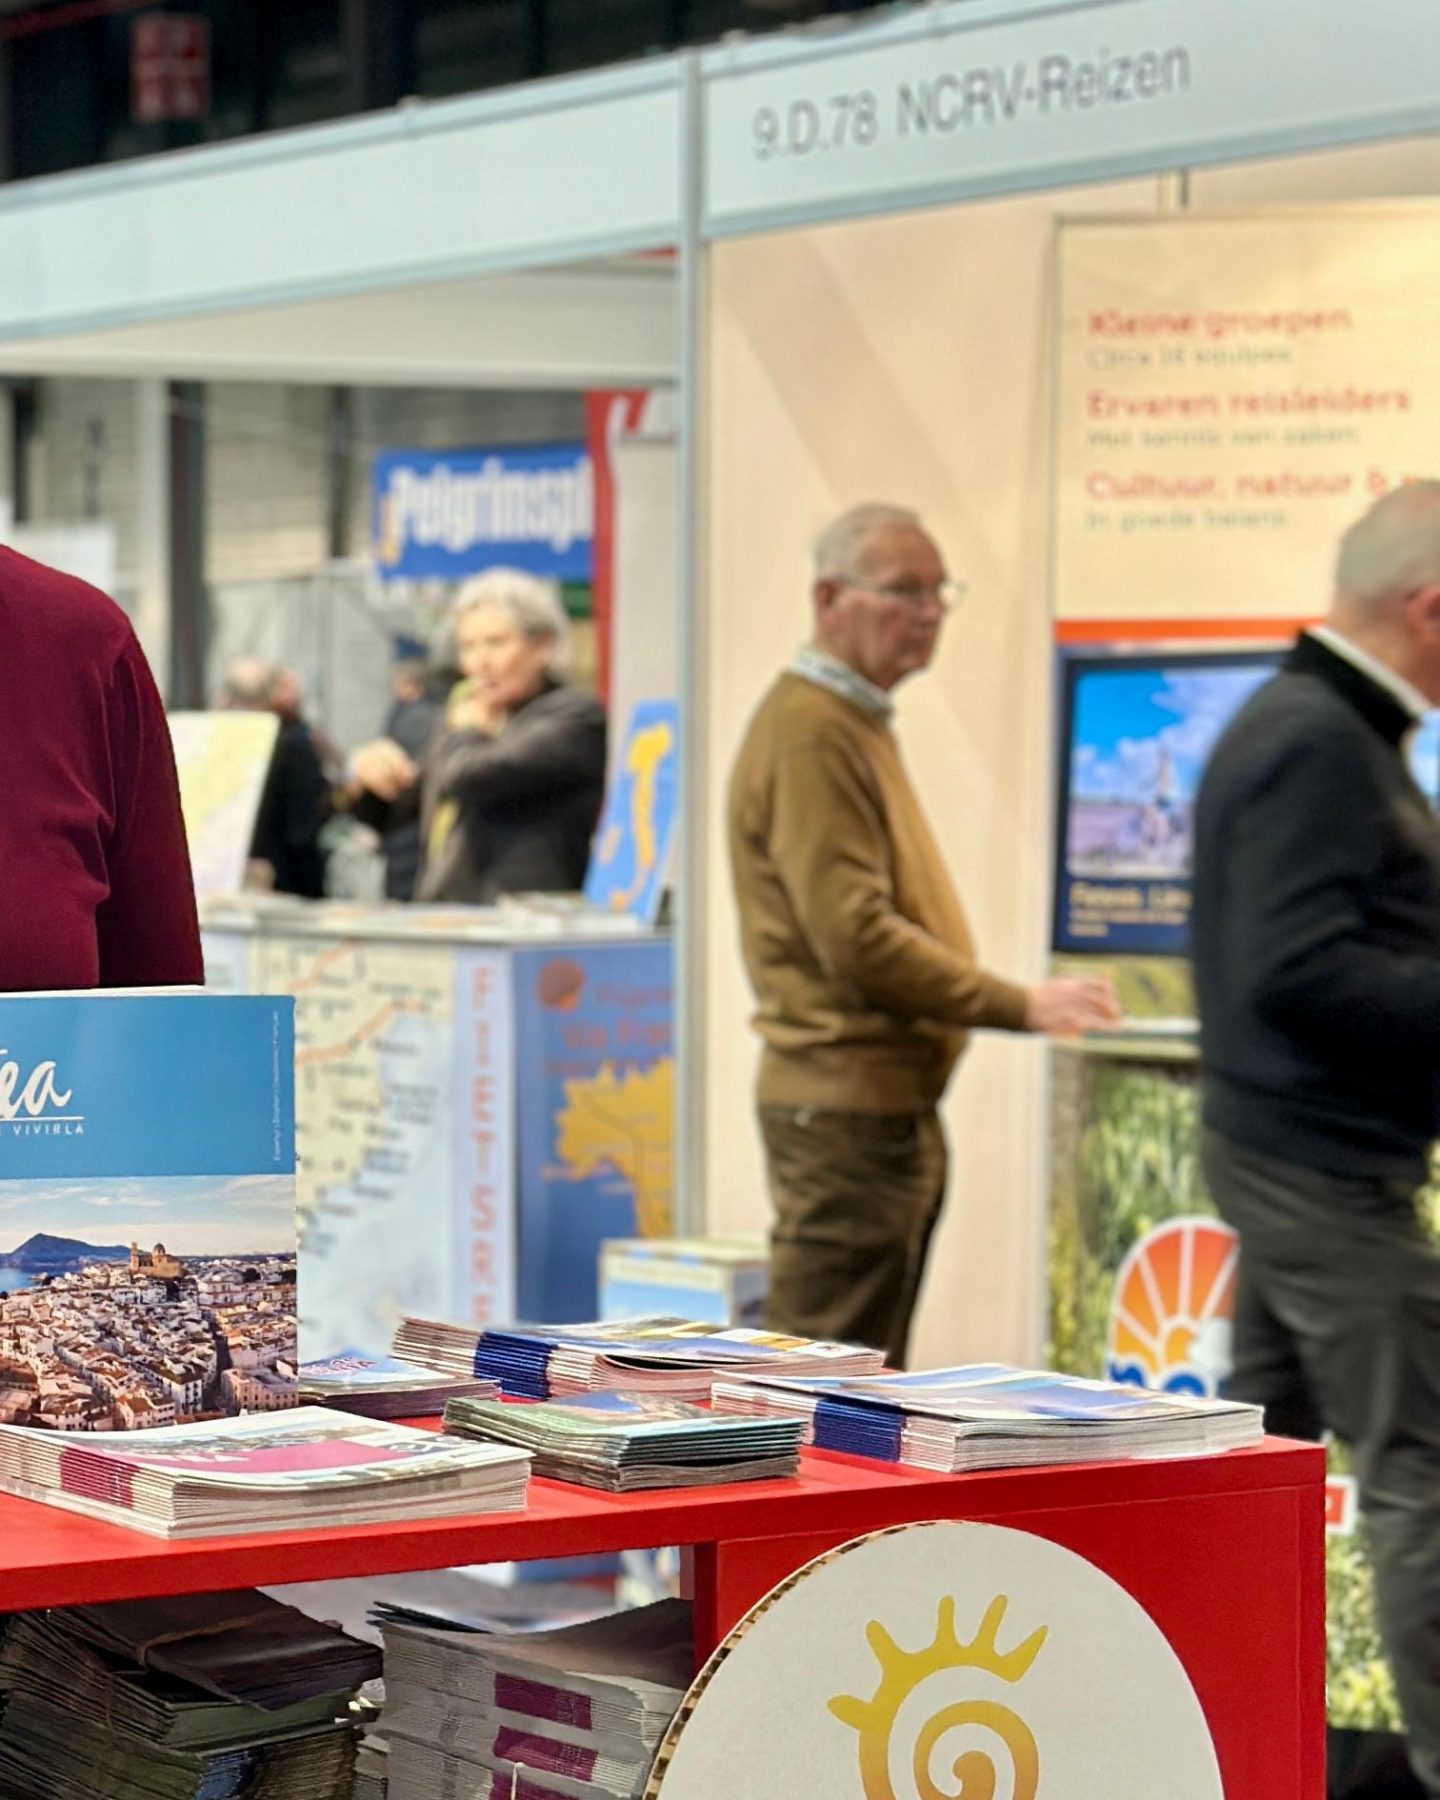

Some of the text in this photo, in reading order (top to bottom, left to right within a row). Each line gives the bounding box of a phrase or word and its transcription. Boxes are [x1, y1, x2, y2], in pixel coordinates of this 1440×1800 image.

[752, 46, 1191, 160] 9.D.78 NCRV-Reizen
[1089, 308, 1351, 339] Kleine groepen
[1088, 389, 1219, 416] Ervaren
[13, 1122, 85, 1136] VIVIRLA
